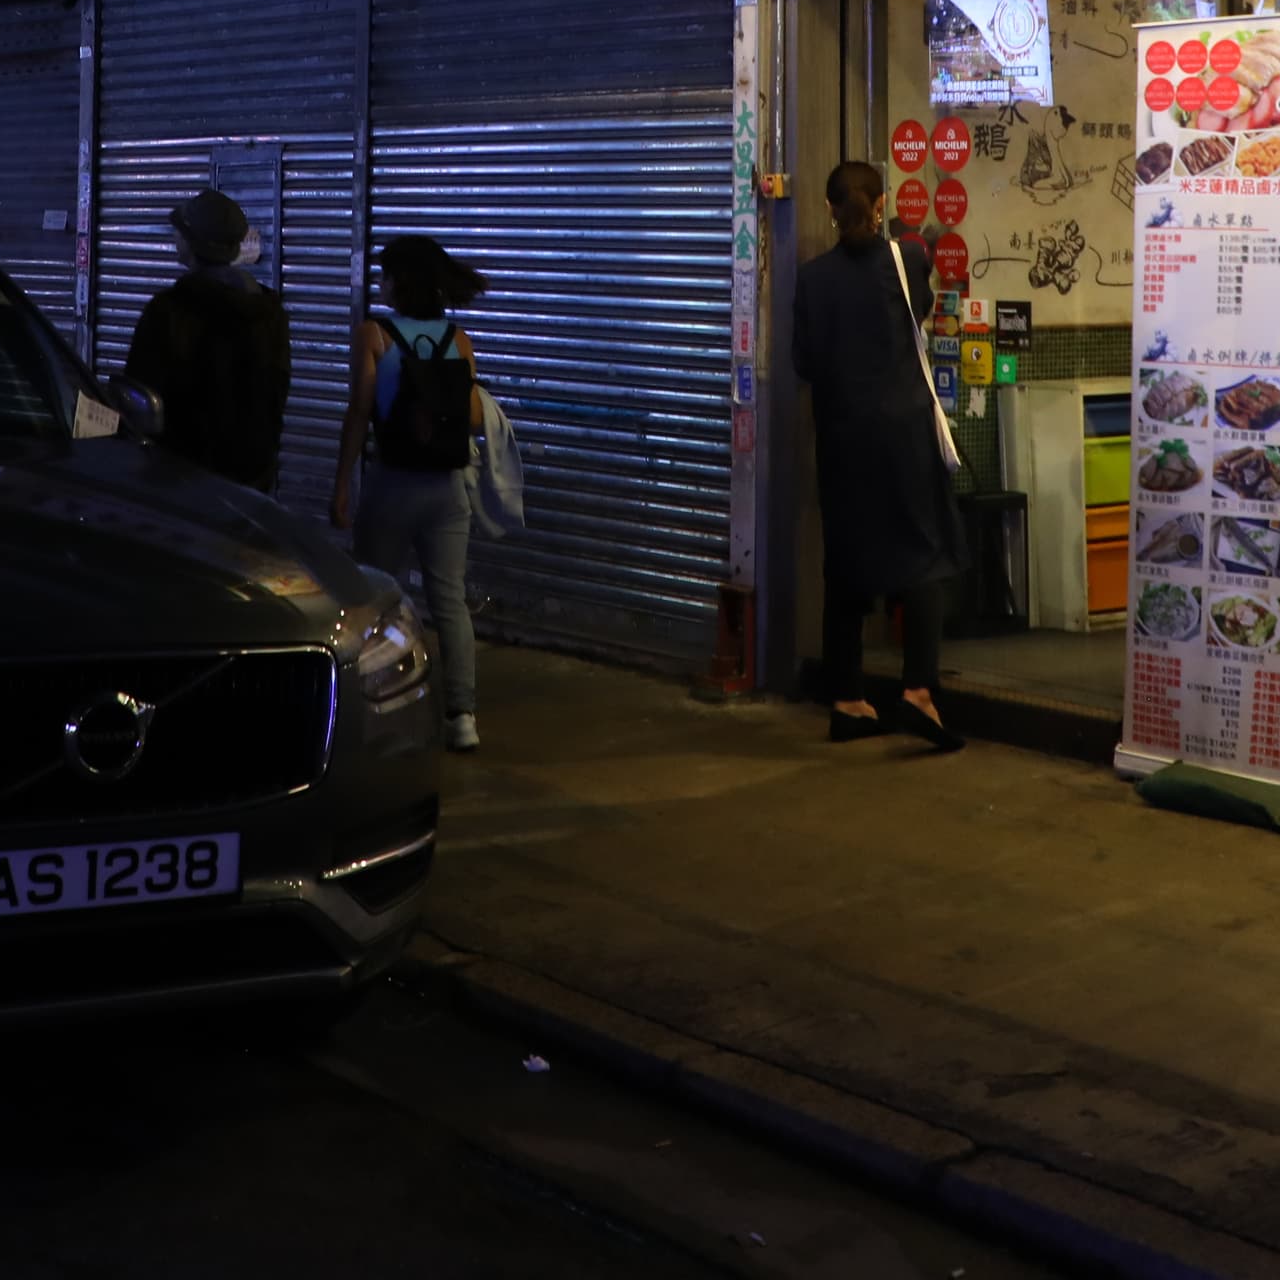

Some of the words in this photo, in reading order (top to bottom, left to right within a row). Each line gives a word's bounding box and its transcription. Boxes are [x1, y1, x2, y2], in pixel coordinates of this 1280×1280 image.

[894, 140, 927, 152] MICHELIN
[934, 139, 968, 151] MICHELIN
[901, 151, 920, 162] 2022
[935, 341, 959, 354] VISA
[86, 840, 218, 901] 1238
